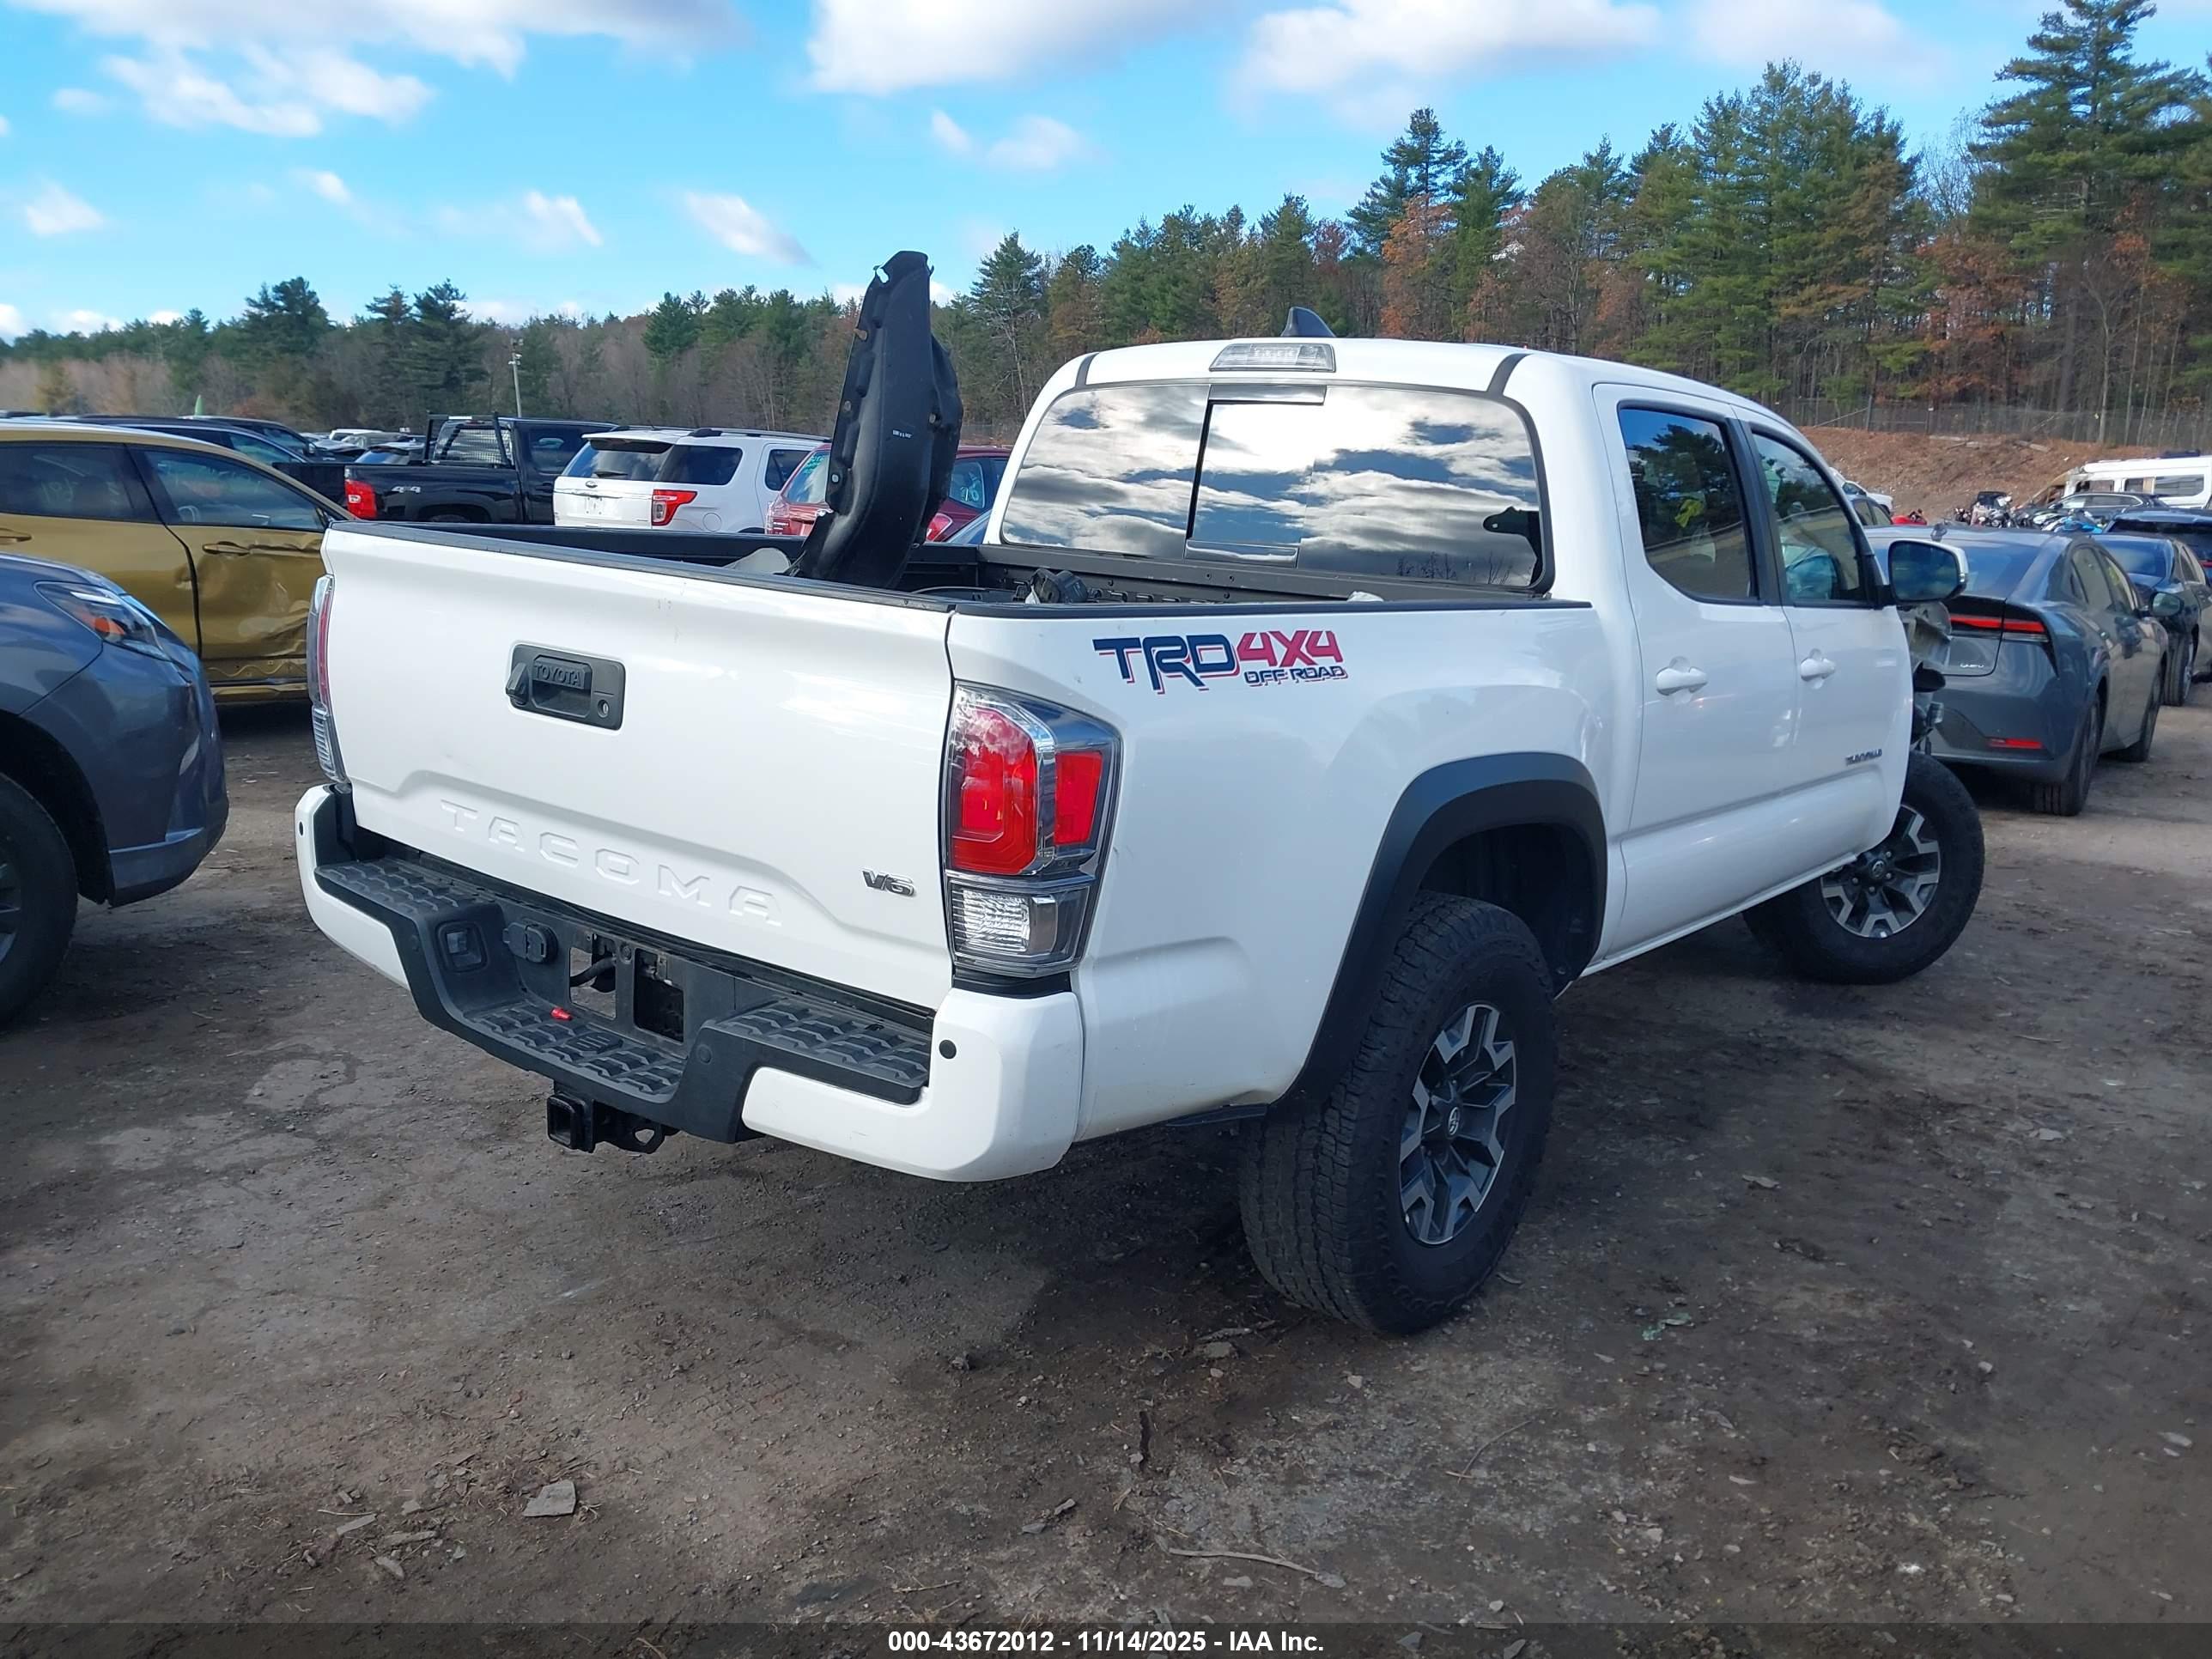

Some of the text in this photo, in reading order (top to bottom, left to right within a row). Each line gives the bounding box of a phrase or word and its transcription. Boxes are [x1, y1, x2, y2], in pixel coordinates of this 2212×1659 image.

[533, 664, 582, 686] TOYOTA
[1092, 634, 1240, 694] TRD
[1244, 665, 1348, 686] OFF ROAD
[441, 799, 782, 926] TACOMA
[861, 870, 915, 897] V6
